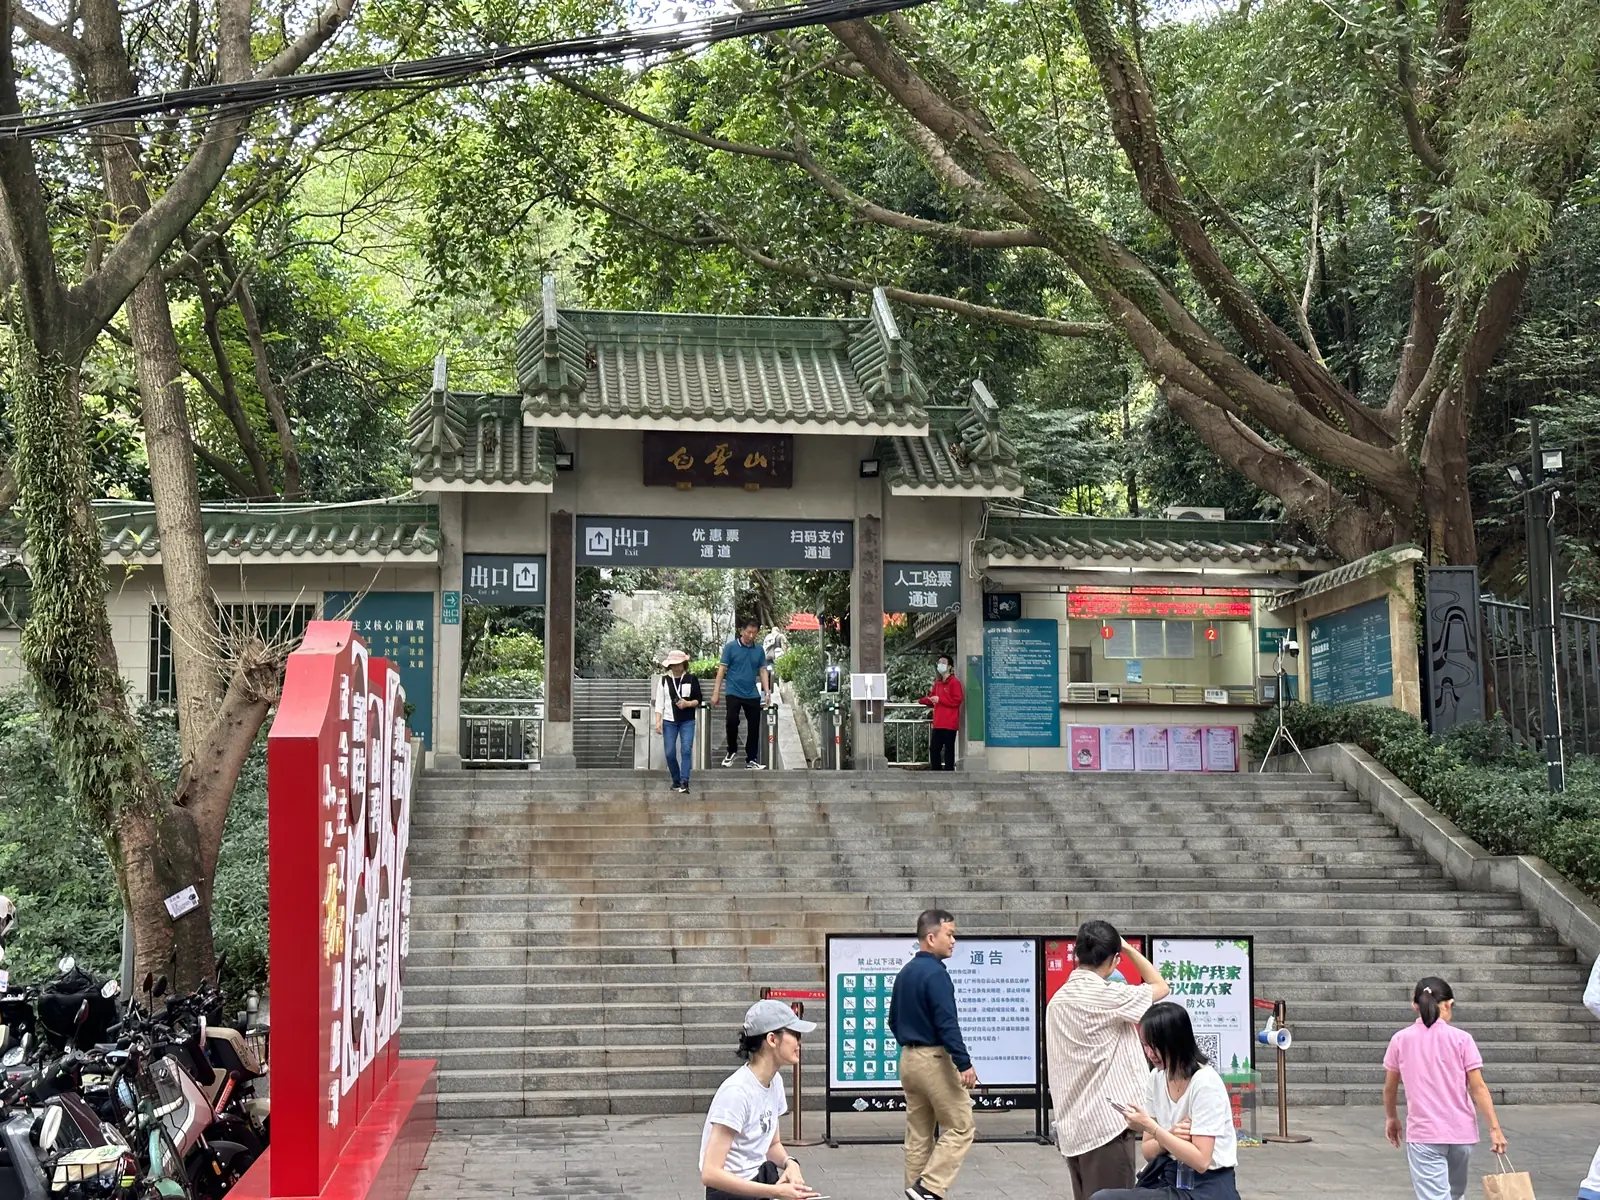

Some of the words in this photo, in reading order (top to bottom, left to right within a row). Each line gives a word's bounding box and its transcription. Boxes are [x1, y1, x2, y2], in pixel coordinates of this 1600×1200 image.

[614, 527, 649, 547] 出口
[692, 528, 739, 542] 优惠票
[790, 530, 845, 544] 扫码支付
[624, 548, 639, 556] Exit
[700, 544, 731, 558] 通道
[804, 545, 831, 560] 通道
[470, 565, 508, 589] 出口
[894, 570, 953, 587] 人工验票
[908, 591, 938, 608] 通道
[443, 609, 459, 617] 出口
[352, 620, 424, 631] 主义核心价值观
[857, 958, 903, 966] 禁止以下活动
[970, 950, 1003, 965] 通告
[1159, 960, 1242, 981] 森林护我家
[1186, 998, 1216, 1008] 防火码
